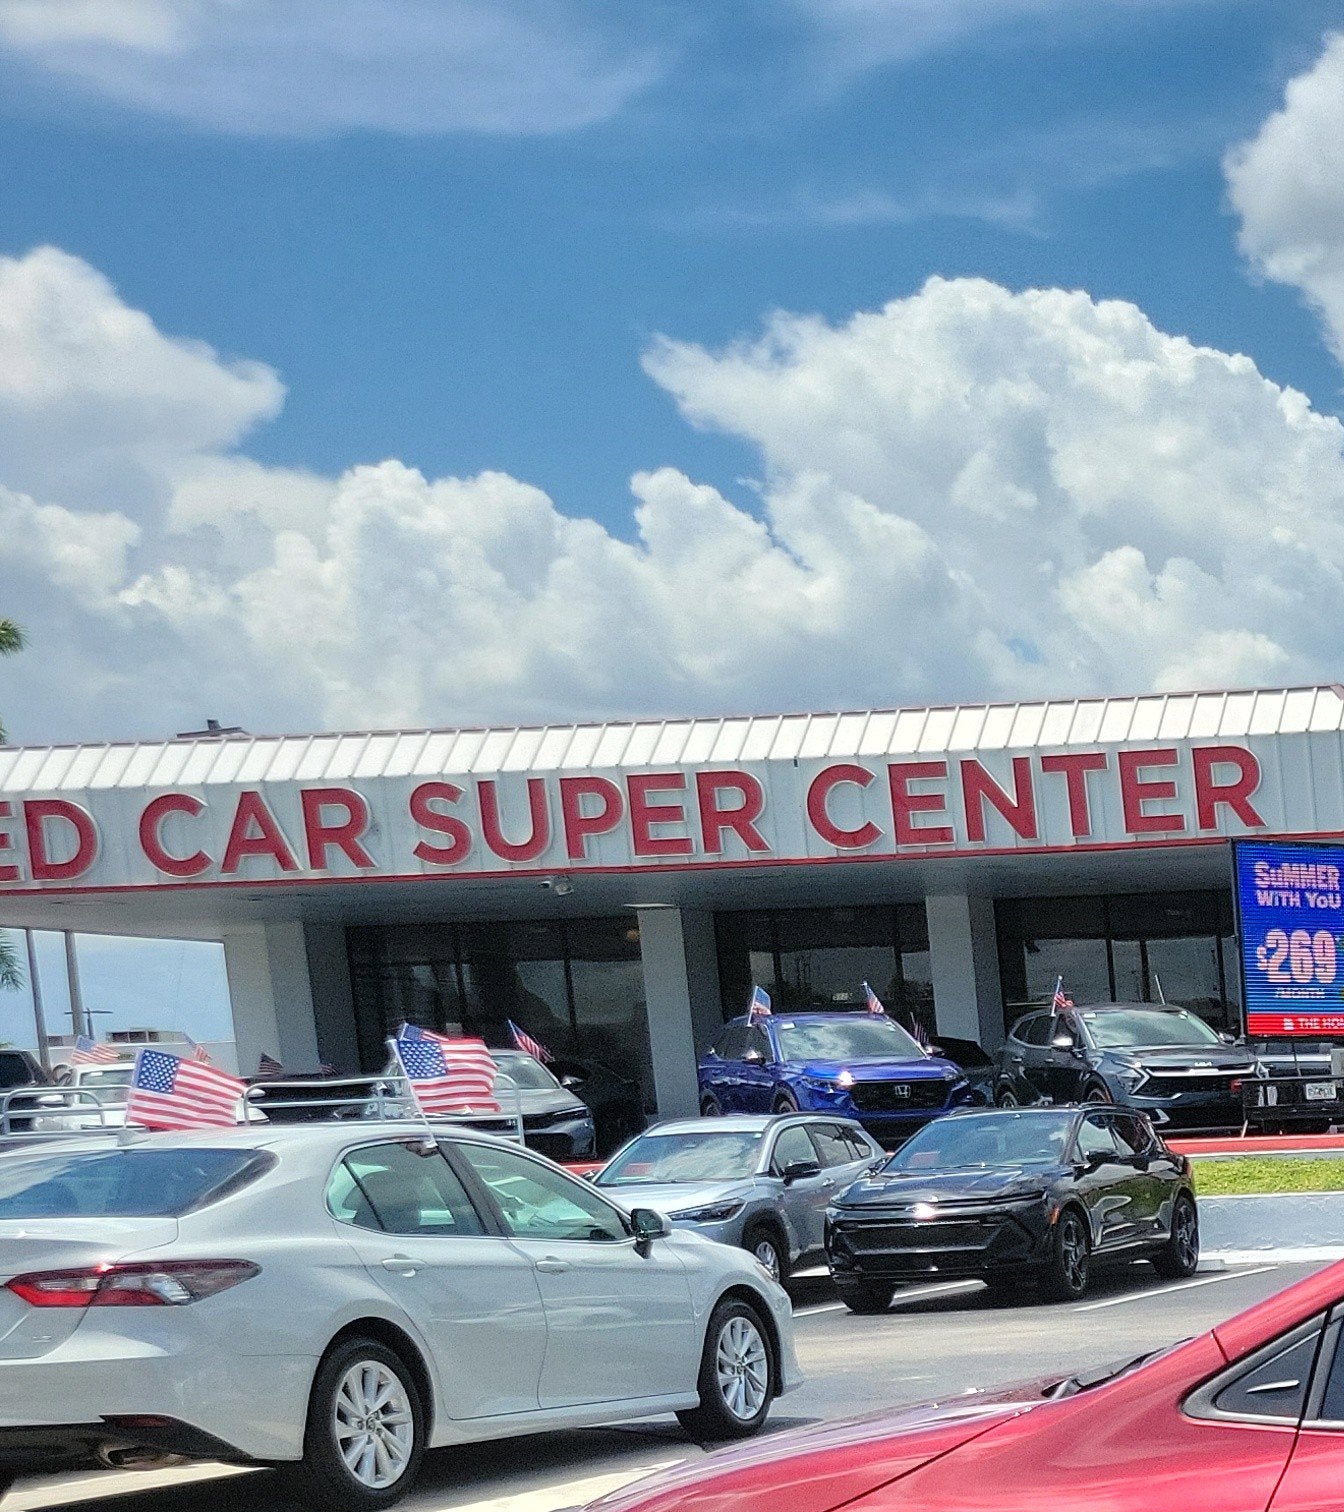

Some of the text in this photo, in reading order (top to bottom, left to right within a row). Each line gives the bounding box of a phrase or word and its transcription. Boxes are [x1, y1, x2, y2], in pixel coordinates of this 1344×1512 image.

[138, 787, 377, 877] CAR
[409, 770, 770, 866] SUPER
[806, 746, 1267, 850] CENTER
[1298, 1017, 1320, 1030] THE
